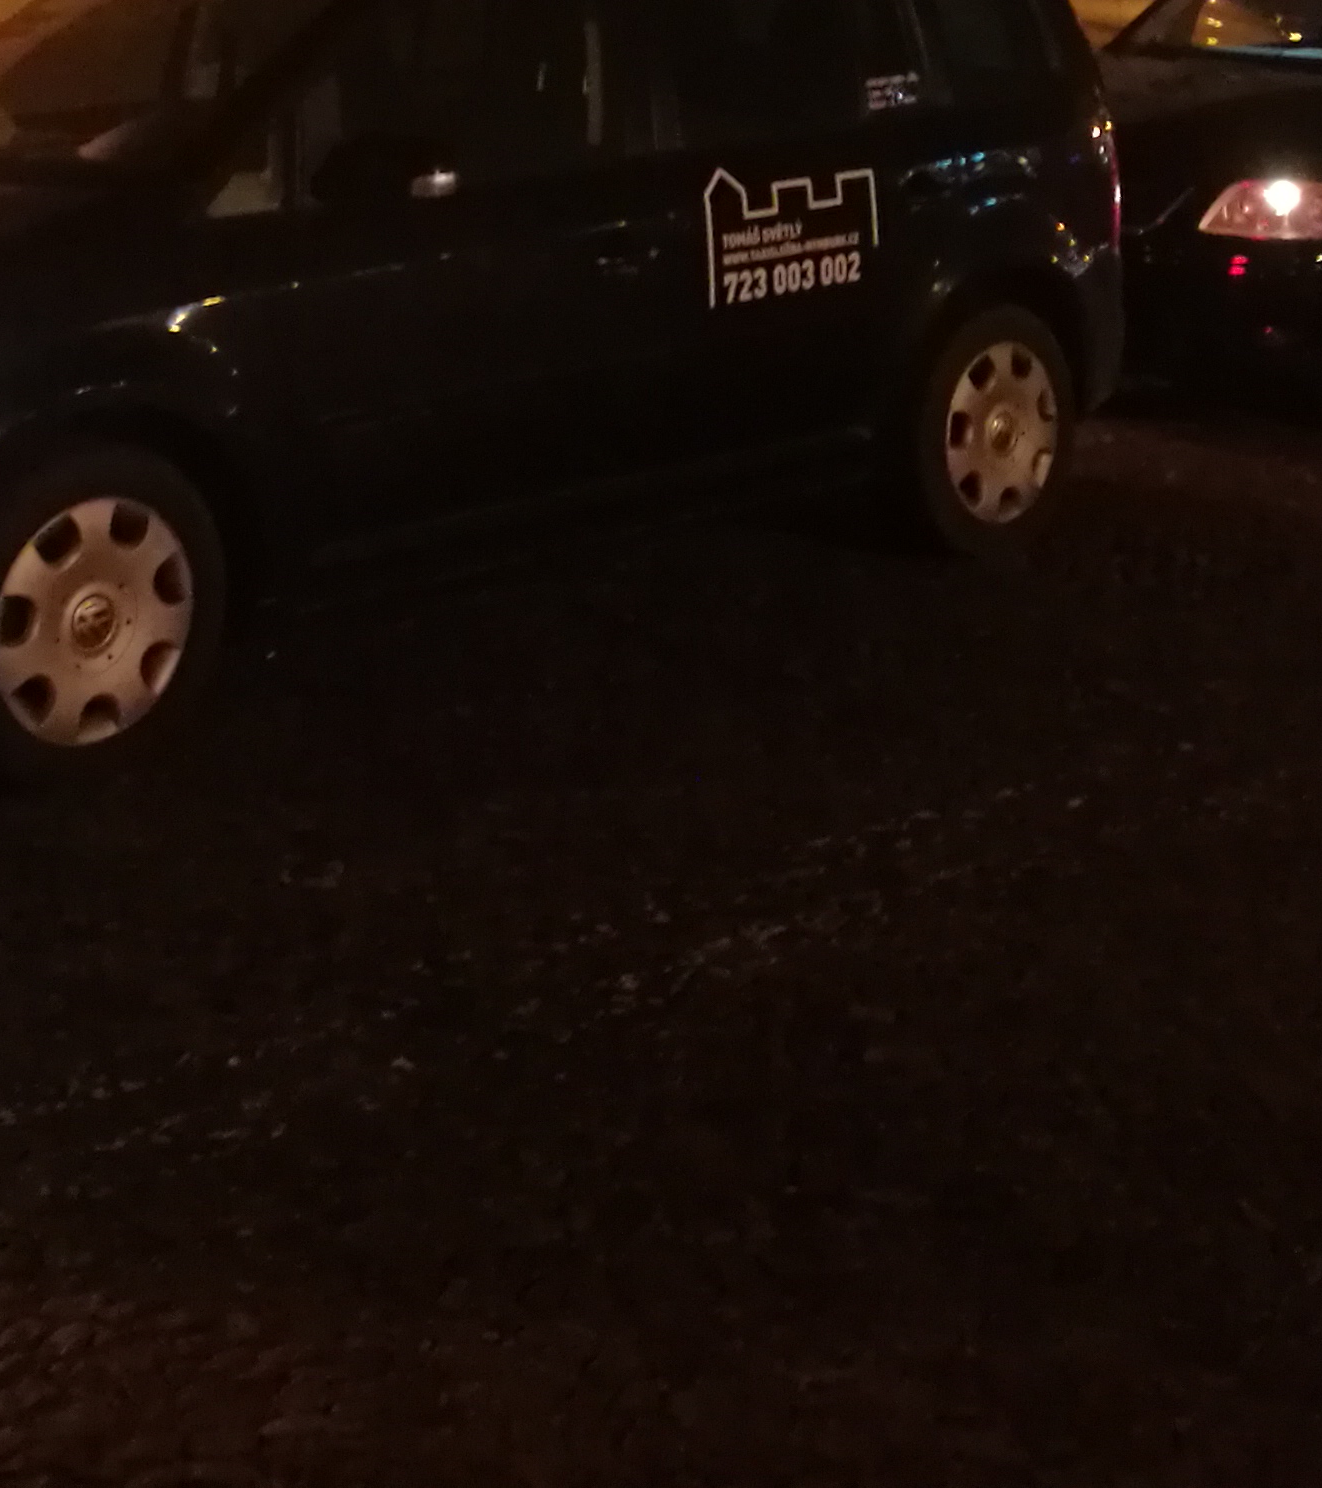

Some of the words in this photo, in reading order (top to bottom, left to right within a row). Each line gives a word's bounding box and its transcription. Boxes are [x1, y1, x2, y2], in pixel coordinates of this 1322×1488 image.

[723, 266, 768, 305] 723
[773, 258, 816, 296] 003
[820, 250, 862, 287] 002
